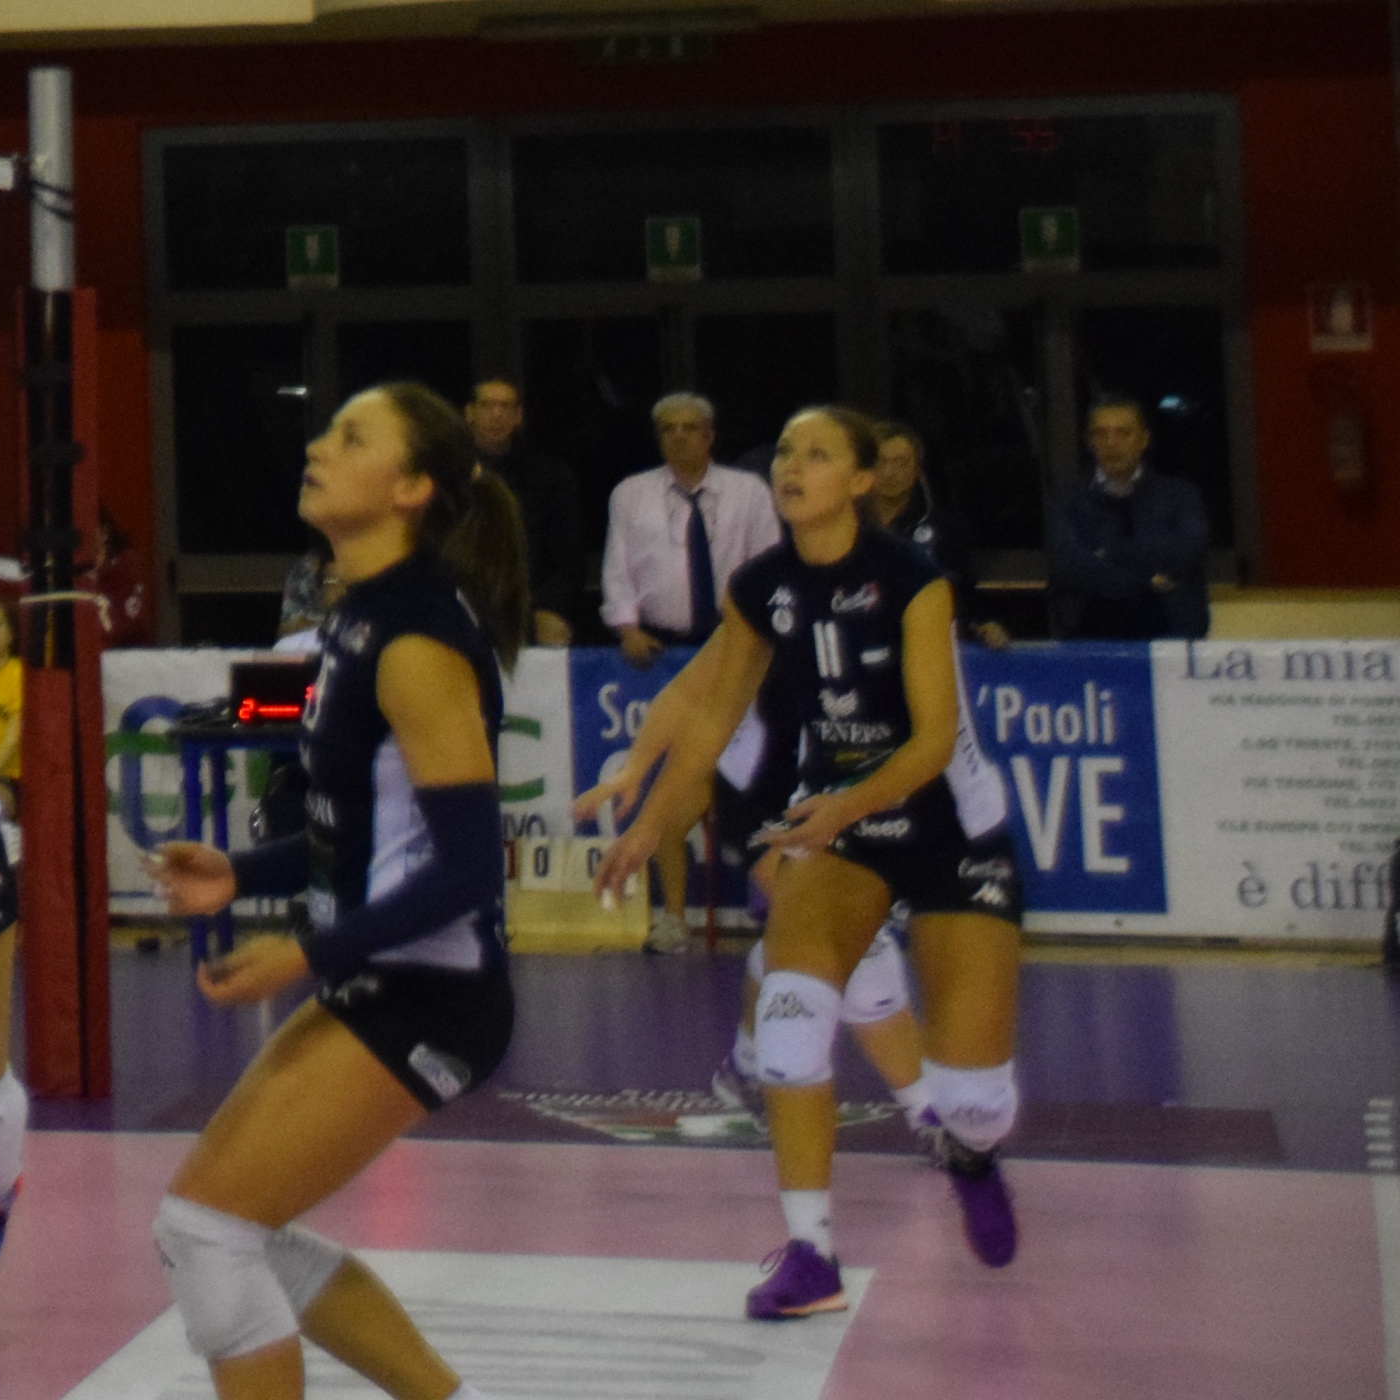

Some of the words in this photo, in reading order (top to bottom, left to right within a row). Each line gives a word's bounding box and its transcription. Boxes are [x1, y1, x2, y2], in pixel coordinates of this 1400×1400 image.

[812, 620, 843, 679] 11
[1181, 641, 1256, 681] La
[1283, 649, 1393, 681] mia
[1237, 860, 1268, 909] è
